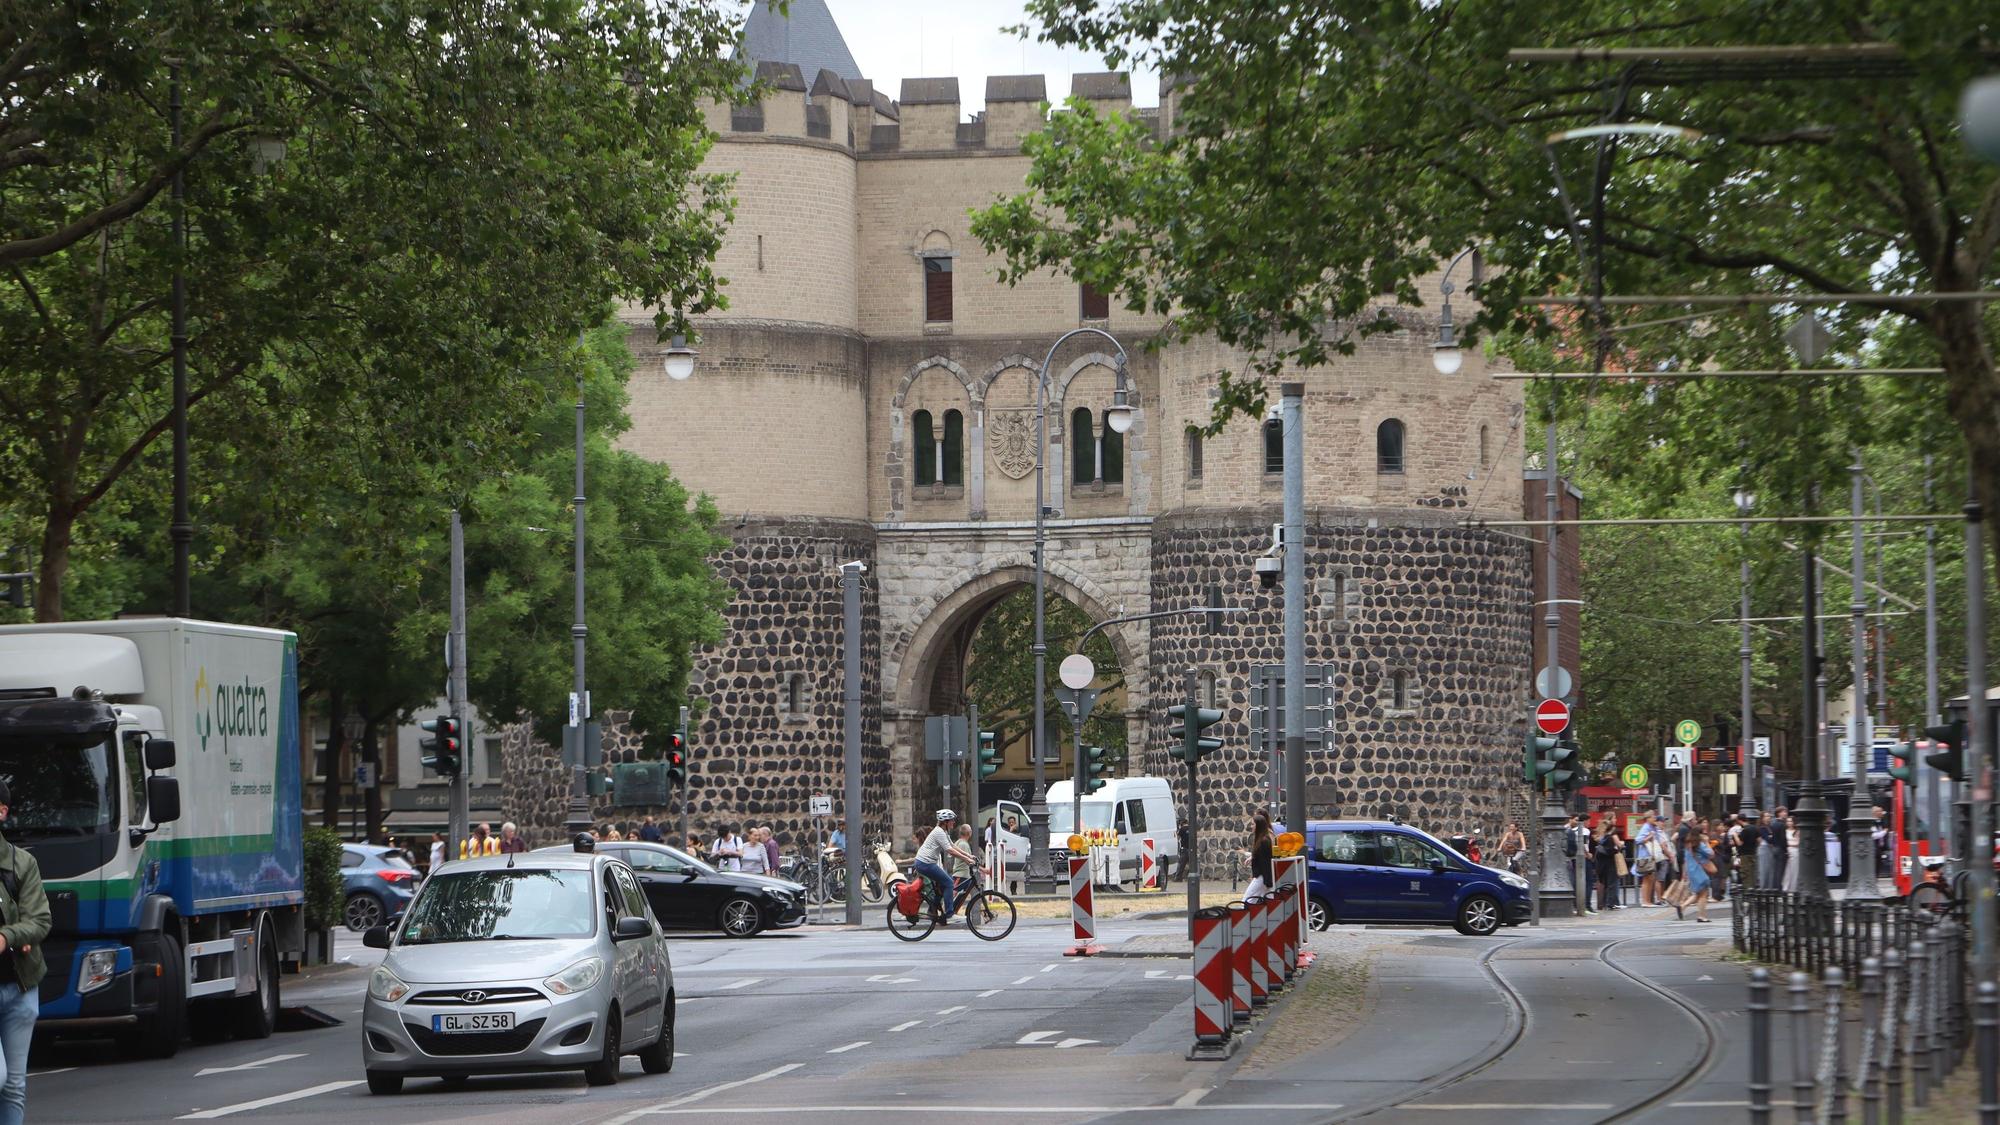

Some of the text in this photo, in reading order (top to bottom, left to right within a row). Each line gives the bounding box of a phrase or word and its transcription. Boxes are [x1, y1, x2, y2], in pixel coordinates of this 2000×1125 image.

[217, 675, 267, 755] quatra
[1682, 726, 1694, 739] H
[1757, 743, 1767, 756] 3
[1668, 753, 1680, 767] A
[1629, 770, 1640, 783] H
[446, 1015, 508, 1030] GL SZ 58
